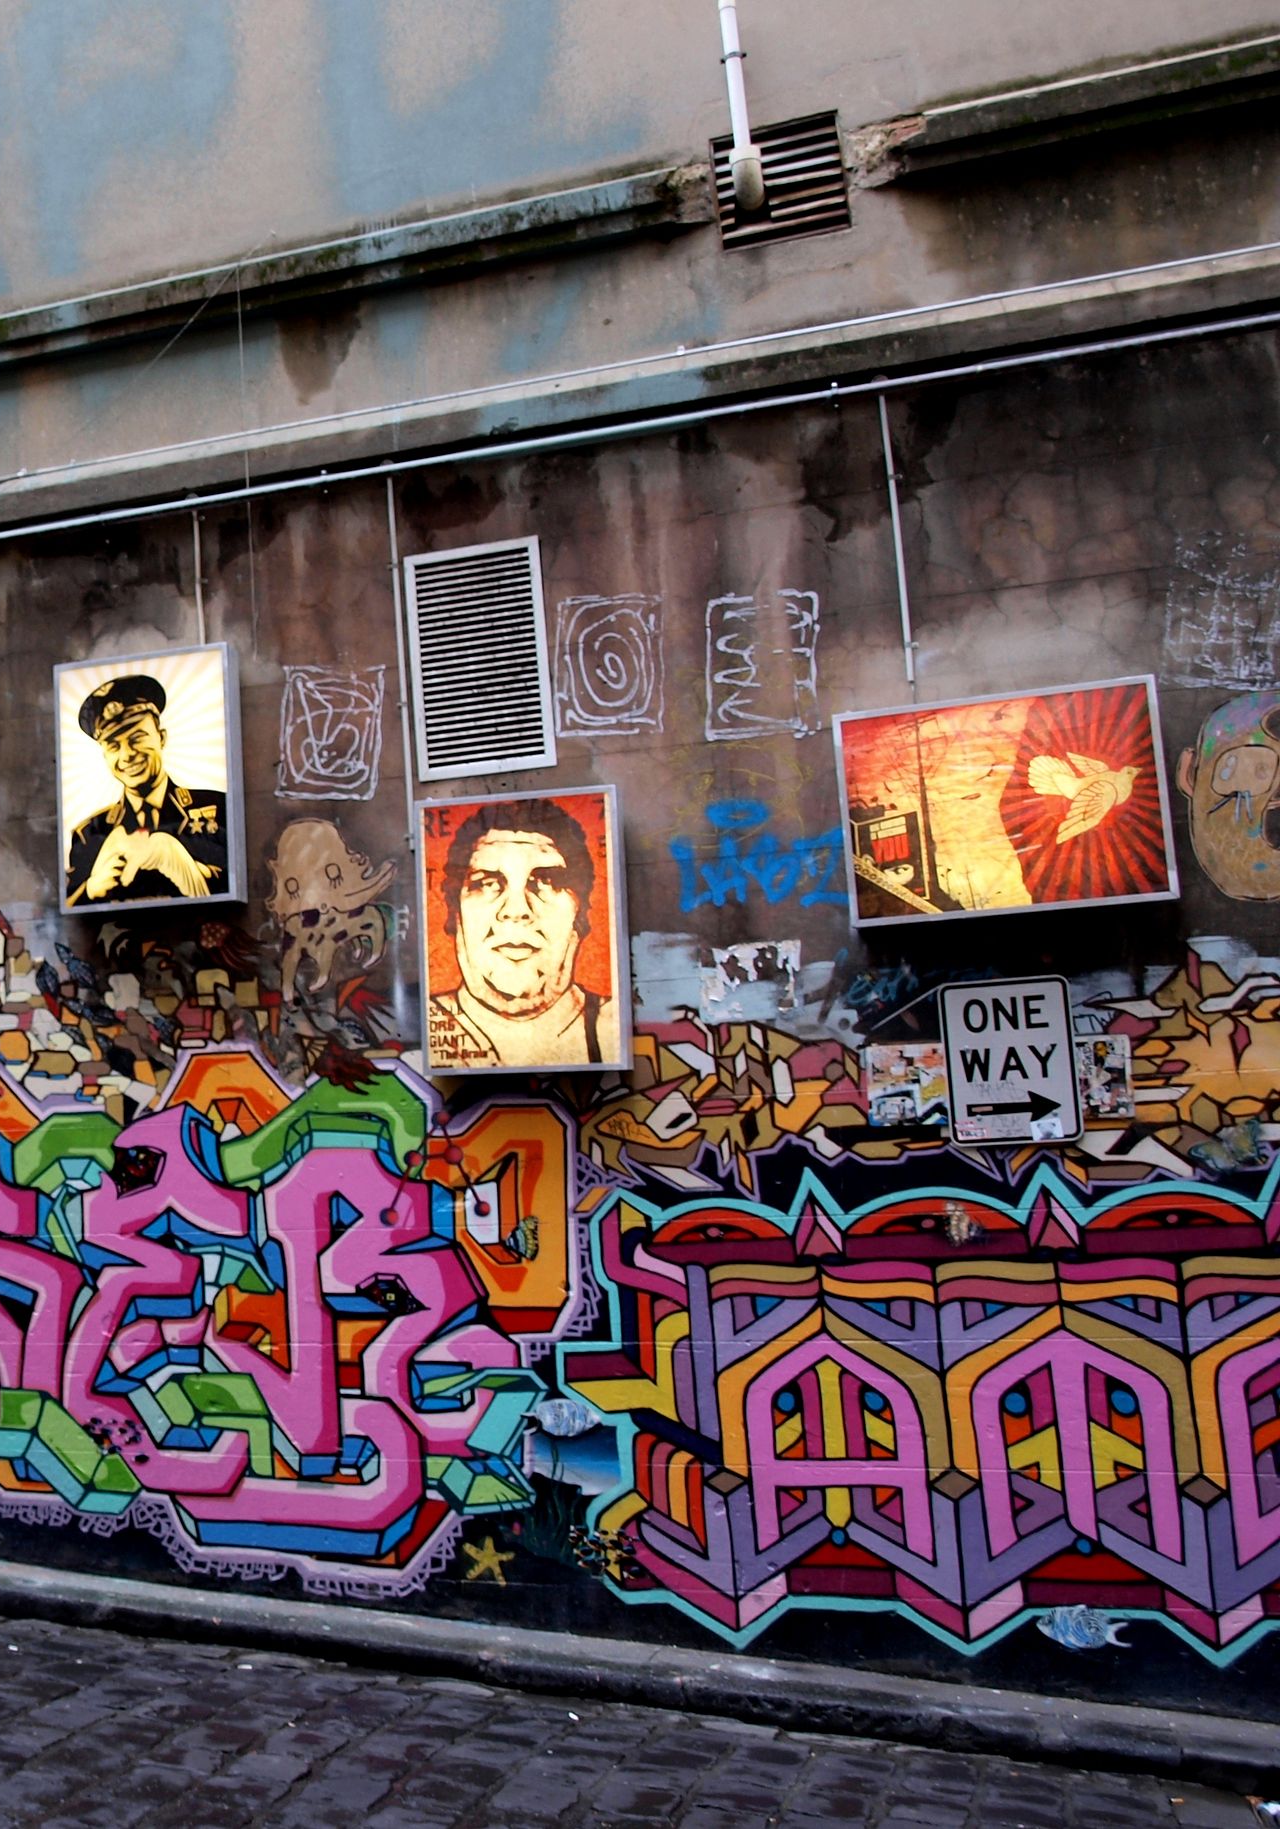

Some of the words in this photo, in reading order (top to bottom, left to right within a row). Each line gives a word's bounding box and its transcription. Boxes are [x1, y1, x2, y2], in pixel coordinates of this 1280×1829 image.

[871, 833, 911, 864] YOU
[962, 994, 1049, 1033] ONE
[429, 1034, 467, 1048] GIANT
[959, 1043, 1057, 1083] WAY
